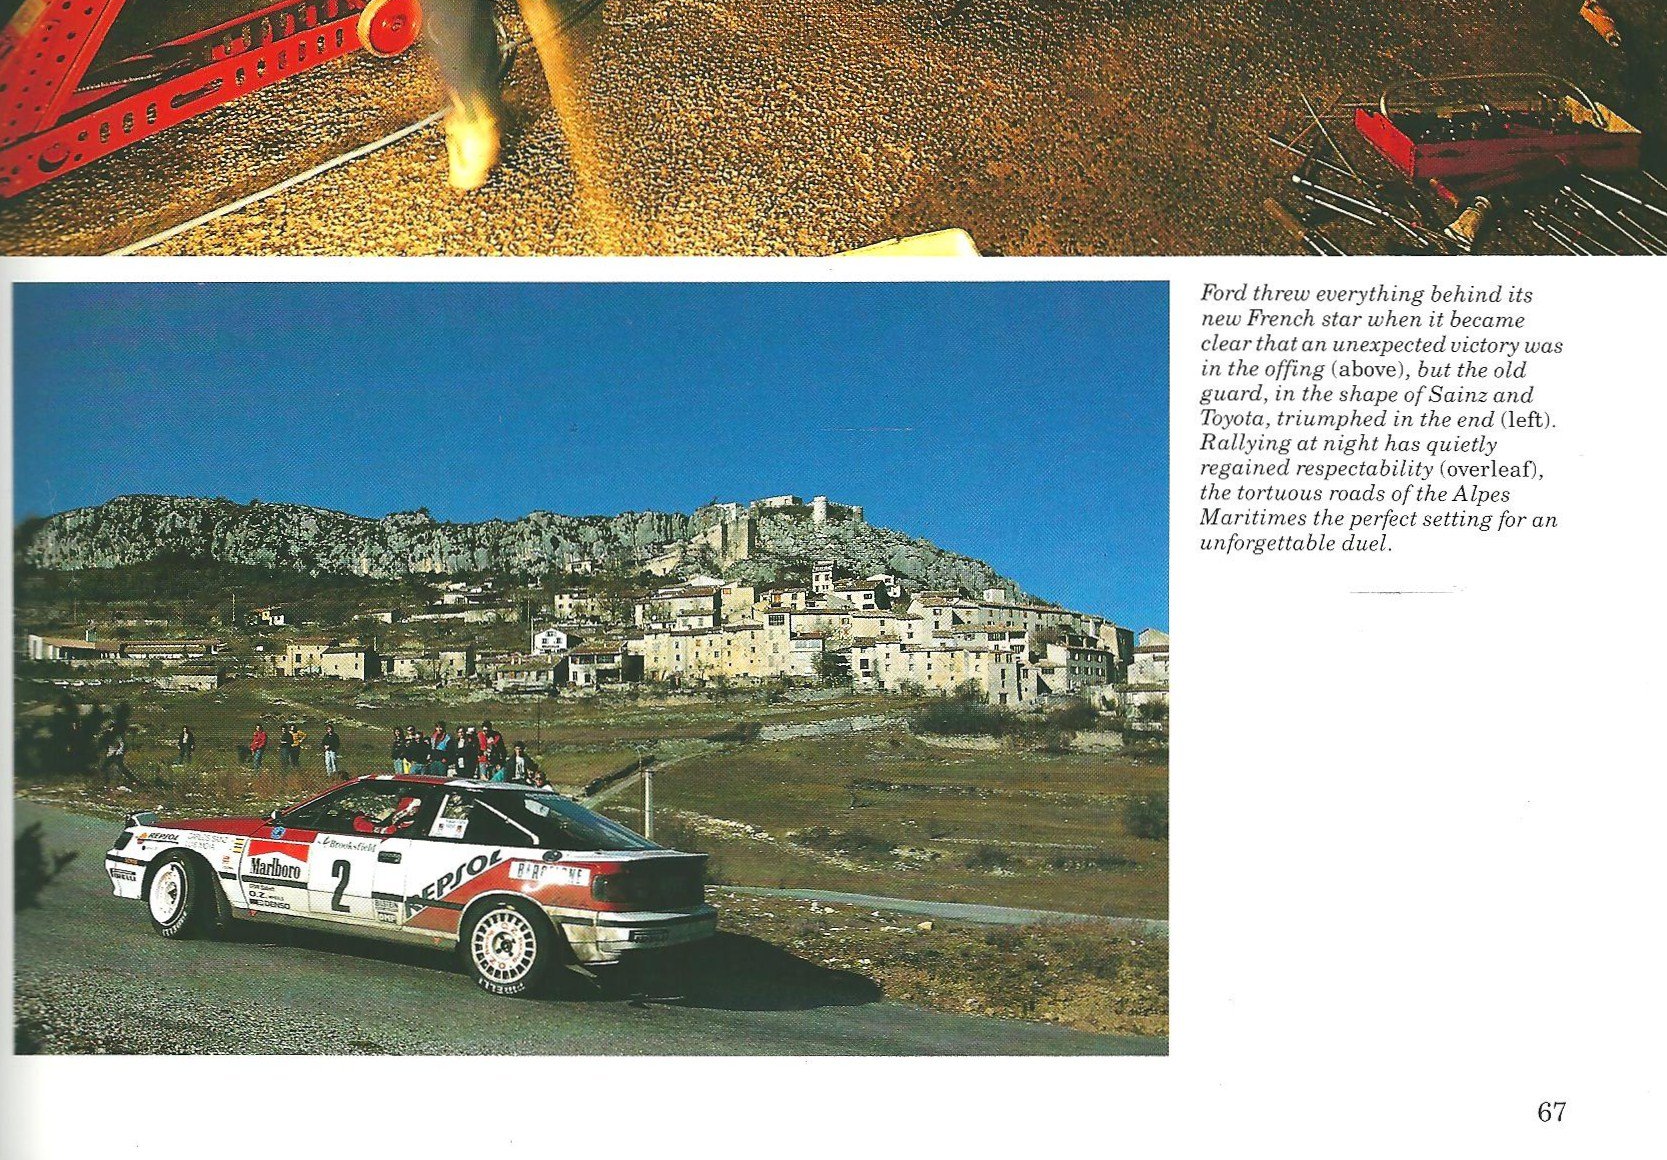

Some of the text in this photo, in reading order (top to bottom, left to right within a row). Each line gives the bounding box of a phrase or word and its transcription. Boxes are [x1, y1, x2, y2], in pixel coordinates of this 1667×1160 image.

[1200, 282, 1534, 307] Ford threw everything behind its
[1201, 308, 1526, 329] new French star when it became
[1200, 333, 1564, 358] clear that an unexpected victory was
[1201, 358, 1527, 381] in the offing (above), but the old
[1199, 383, 1534, 407] guard, in the shape of Sainz and
[1200, 408, 1556, 431] Toyota, triumphed in the end (left).
[1199, 432, 1498, 457] Rallying at night has quietly
[1200, 457, 1544, 481] regained respectability (overleaf),
[1200, 482, 1511, 507] the tortuous roads of the Alpes
[1199, 507, 1558, 532] Maritimes the perfect setting for an
[1200, 532, 1392, 556] unforgettable duel.
[148, 832, 179, 840] REPSOL
[110, 867, 137, 882] PIRELLI
[250, 857, 301, 879] Marlboro
[331, 859, 351, 913] 2
[1538, 1101, 1567, 1123] 67
